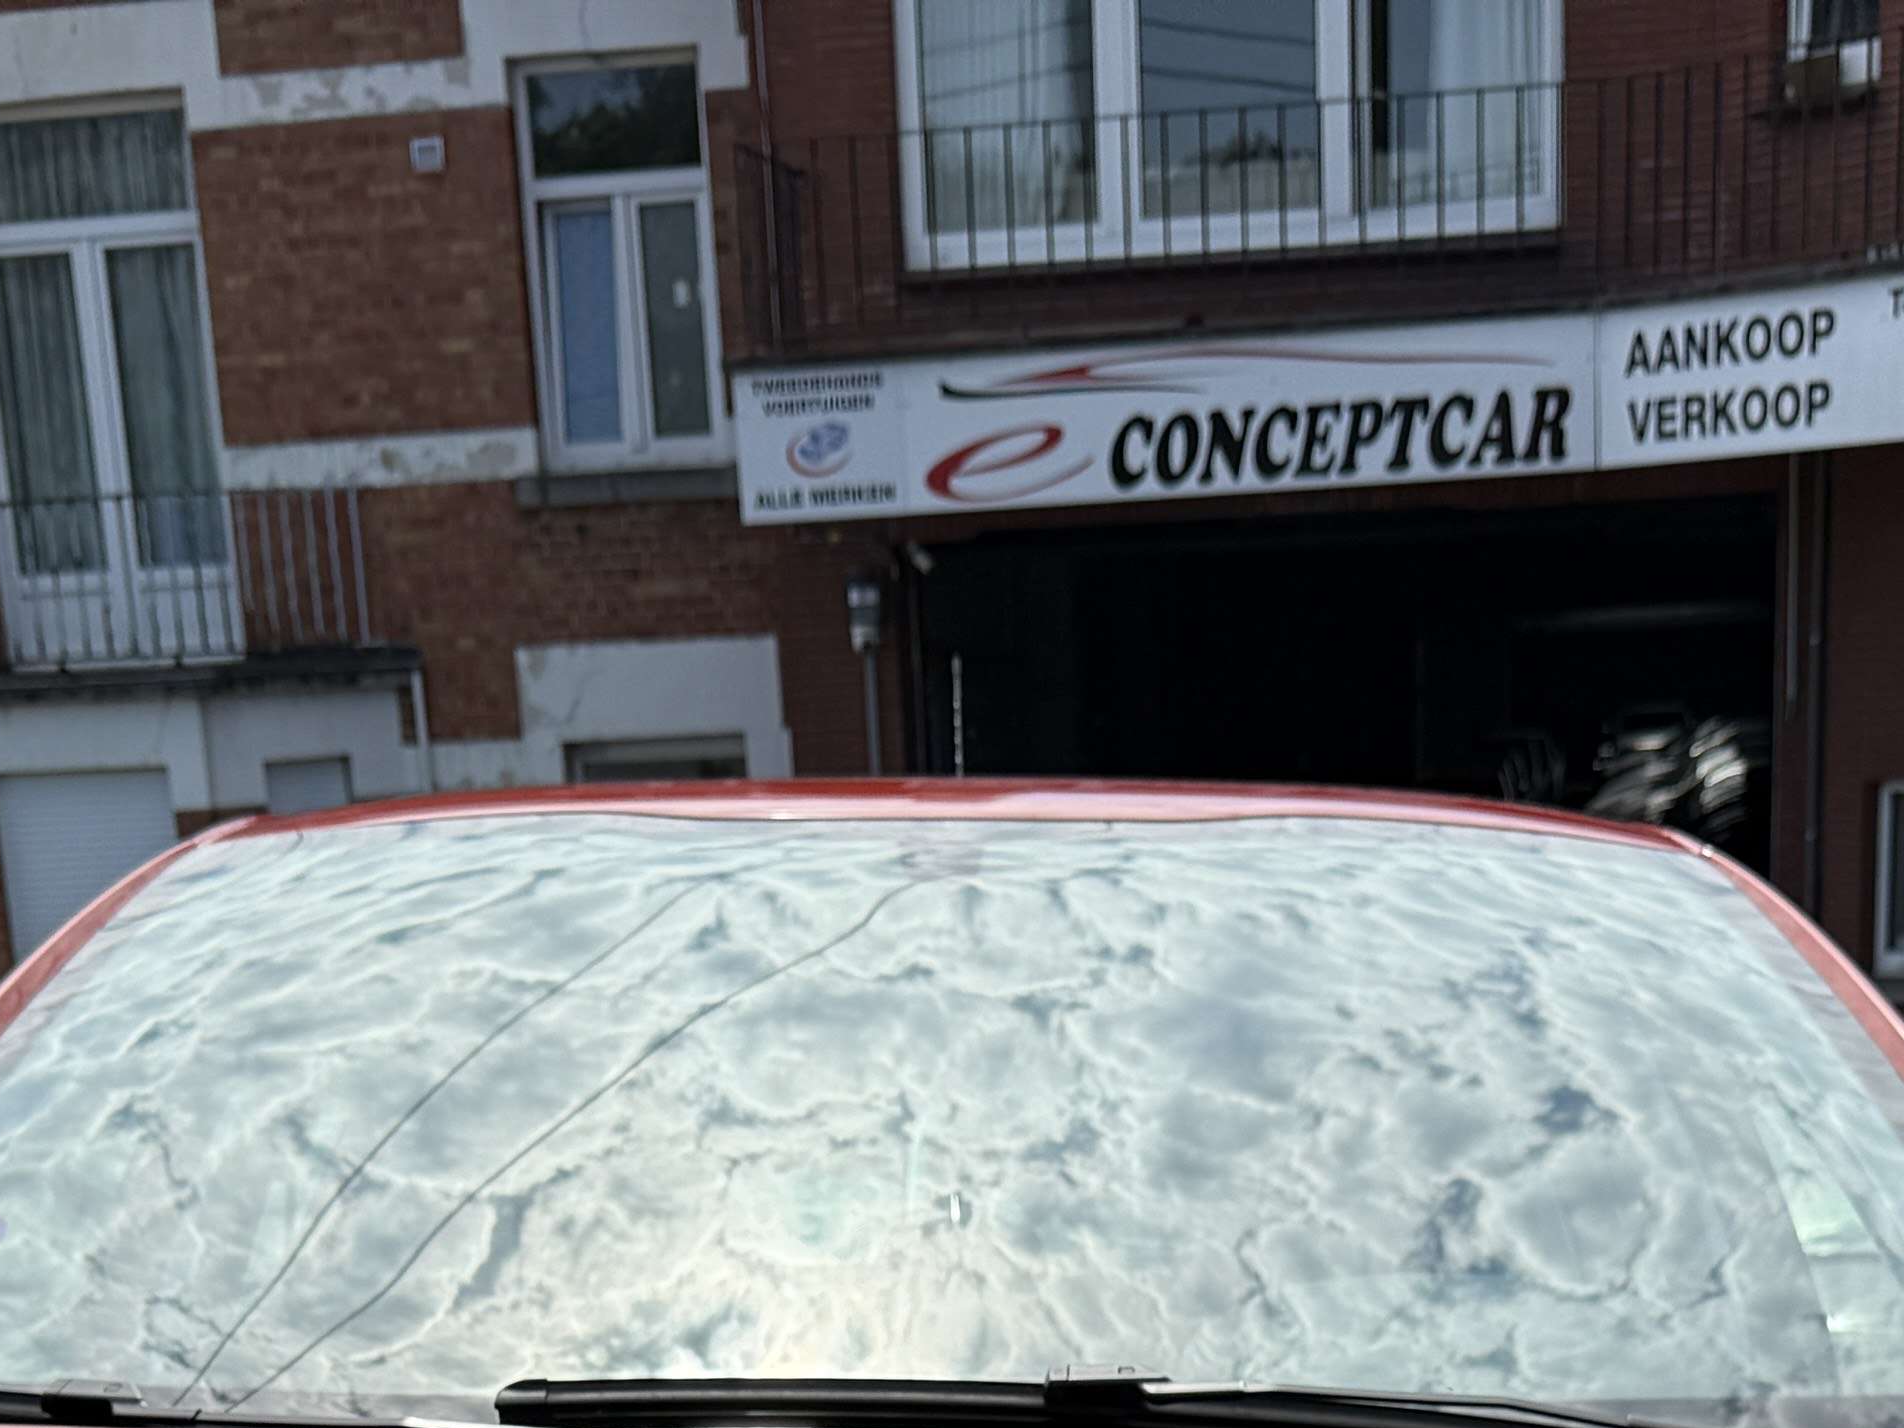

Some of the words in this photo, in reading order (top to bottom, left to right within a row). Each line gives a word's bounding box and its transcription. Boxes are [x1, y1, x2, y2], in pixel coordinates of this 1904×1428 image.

[1625, 308, 1835, 377] AANKOOP
[1110, 387, 1571, 490] CONCEPTCAR
[1628, 381, 1830, 444] VERKOOP
